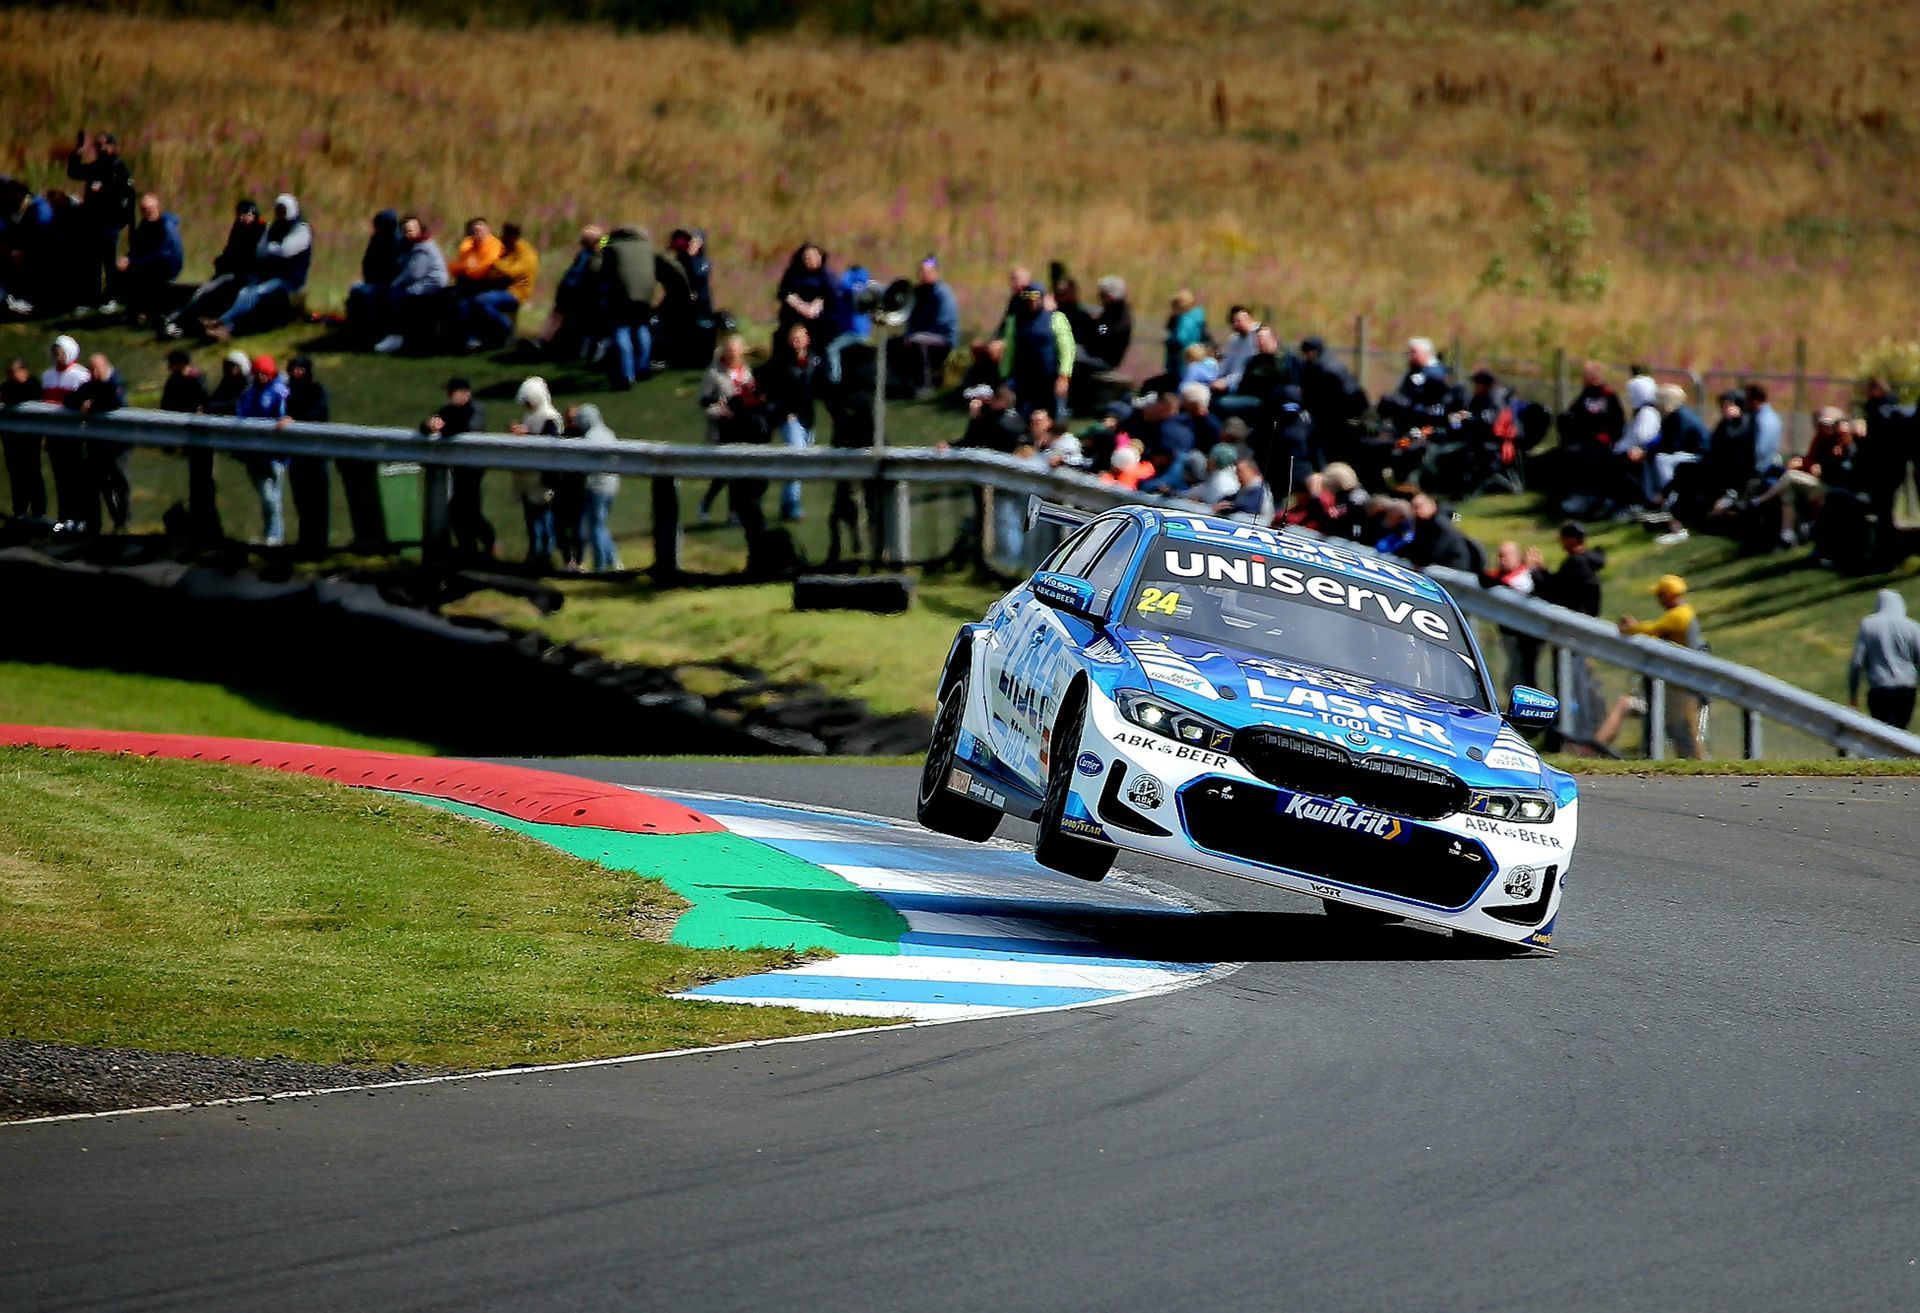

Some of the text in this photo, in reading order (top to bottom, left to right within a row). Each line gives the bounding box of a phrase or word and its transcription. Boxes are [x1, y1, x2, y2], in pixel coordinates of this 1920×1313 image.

[1187, 519, 1414, 583] LASER
[1268, 544, 1348, 571] TOOLS
[1055, 592, 1076, 605] BEER
[1137, 587, 1181, 615] 24
[1246, 677, 1455, 747] LASER
[1317, 711, 1394, 739] TOOLS
[1113, 732, 1228, 769] ABK BEER
[1078, 756, 1100, 771] Carrier
[1135, 795, 1153, 806] ABK
[1221, 793, 1235, 801] TOW
[1465, 817, 1564, 850] ABK BEER
[1448, 848, 1461, 856] TOW
[1309, 882, 1341, 898] WSR
[1510, 886, 1528, 896] ABK
